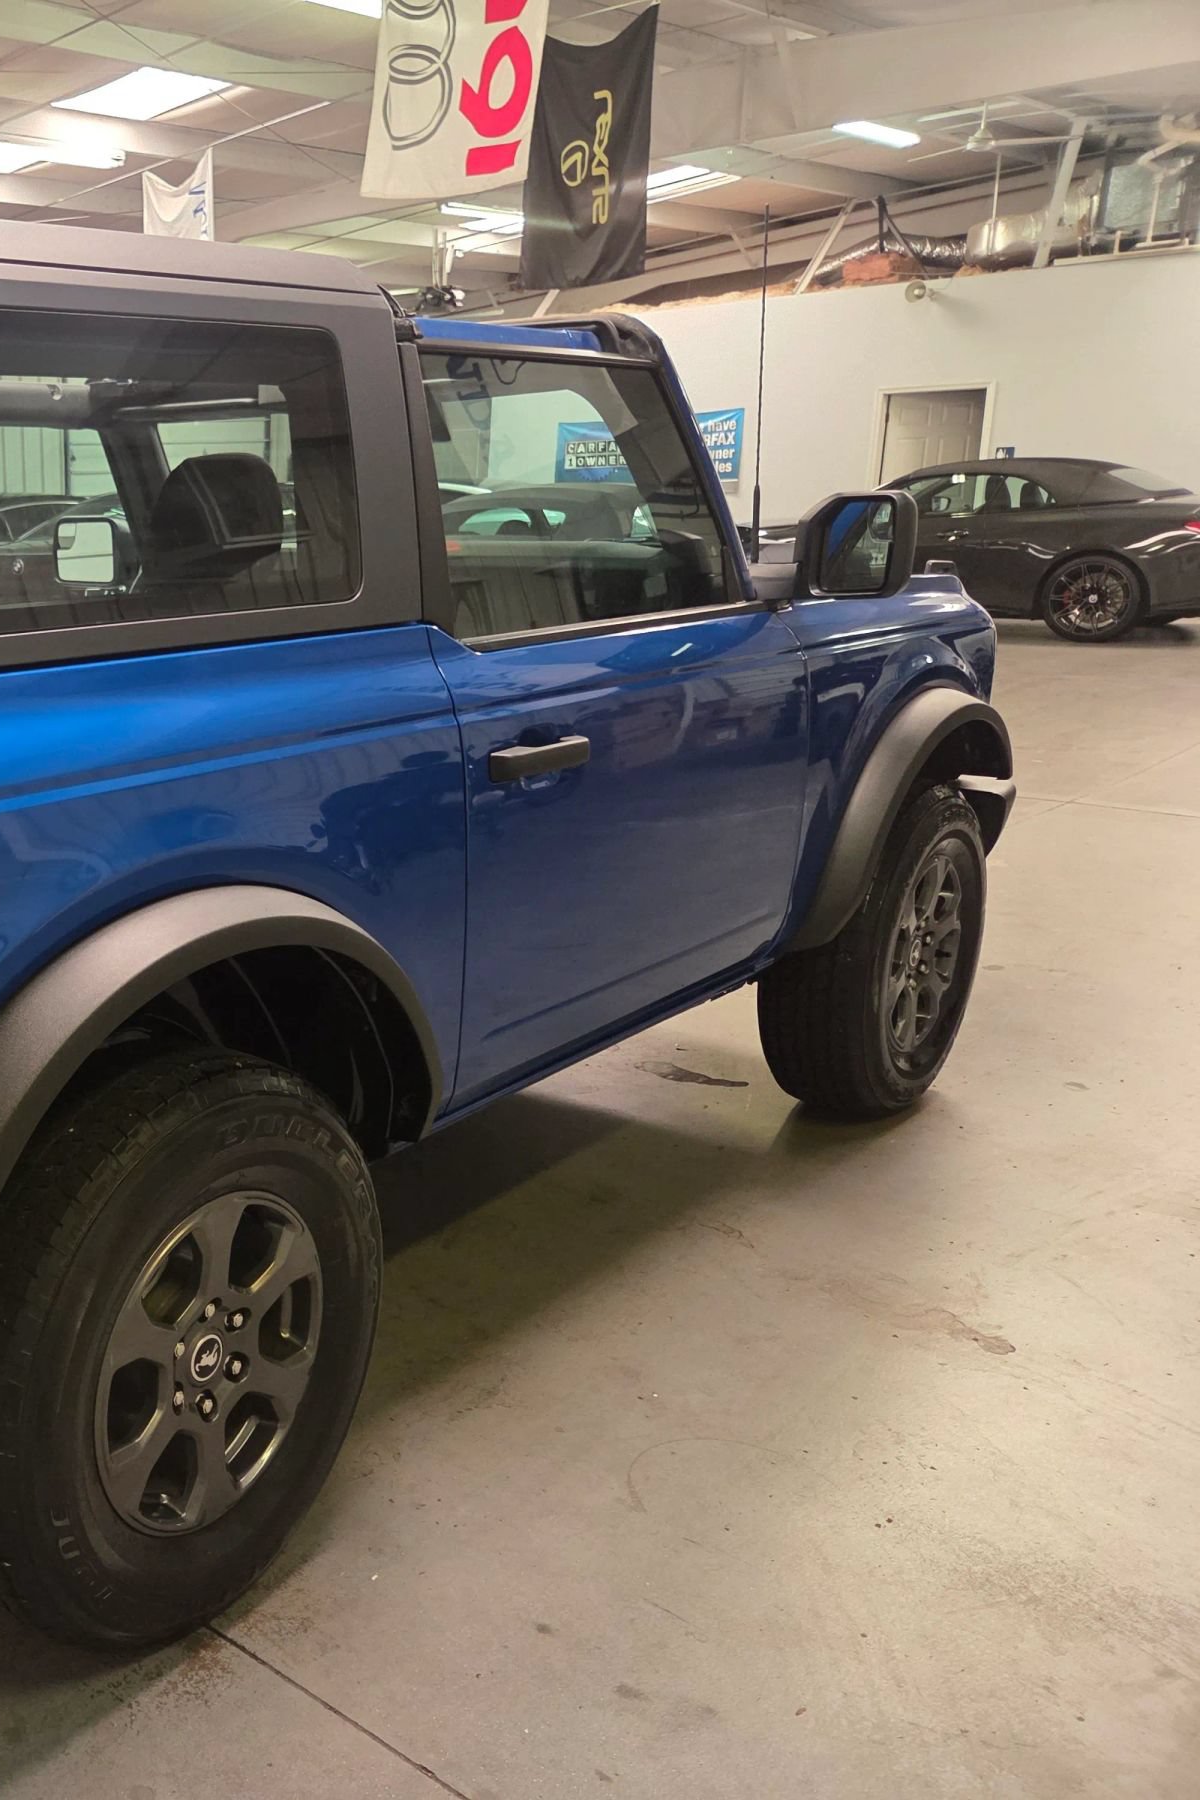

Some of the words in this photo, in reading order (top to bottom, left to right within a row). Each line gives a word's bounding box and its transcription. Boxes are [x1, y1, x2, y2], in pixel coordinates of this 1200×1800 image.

[708, 419, 737, 431] have
[704, 432, 736, 446] RFAX
[567, 440, 621, 454] CARFA
[715, 461, 733, 473] les
